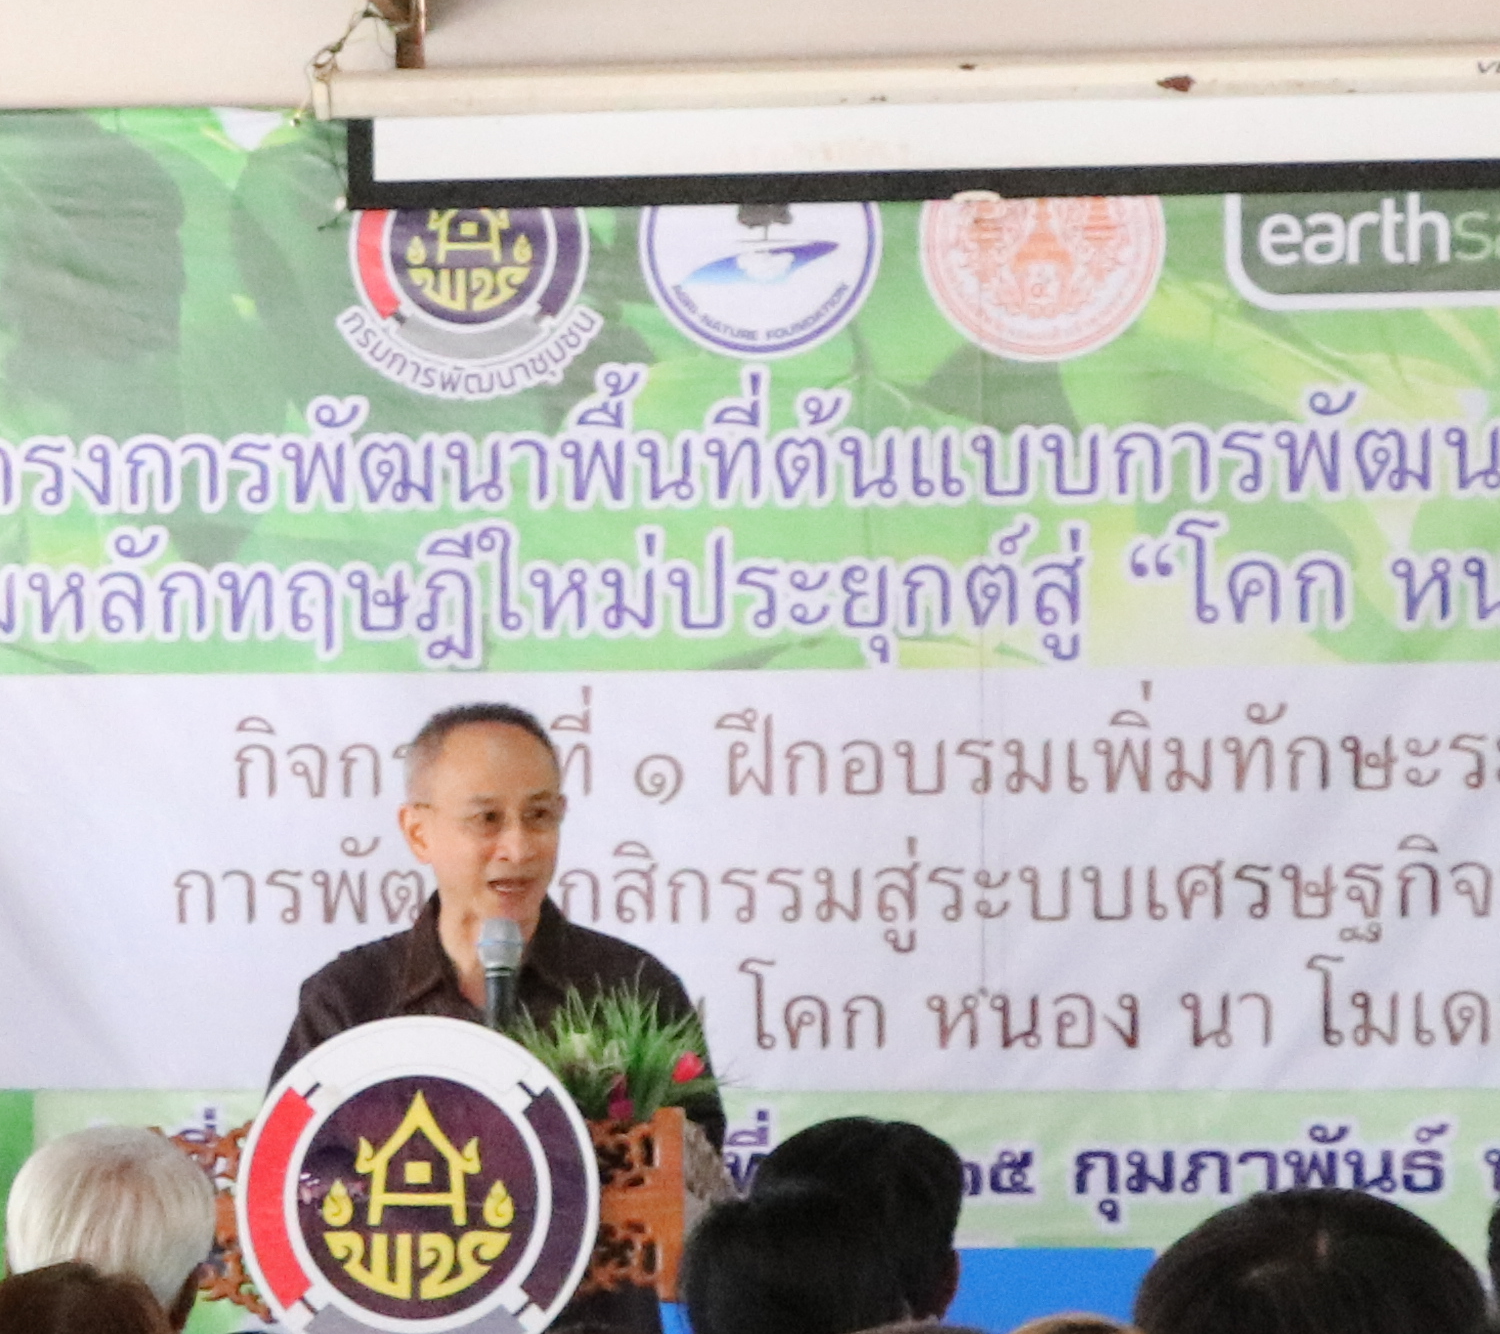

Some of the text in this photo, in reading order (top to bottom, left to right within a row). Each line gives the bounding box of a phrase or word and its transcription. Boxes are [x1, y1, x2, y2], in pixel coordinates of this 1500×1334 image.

[342, 310, 597, 394] กรมการพัฒนาชุมชน
[632, 751, 685, 804] ๑
[738, 957, 886, 1050] โคก
[926, 990, 1139, 1050] หนอง
[1180, 989, 1273, 1049] นา
[1074, 1123, 1450, 1223] กุมภาพันธ์
